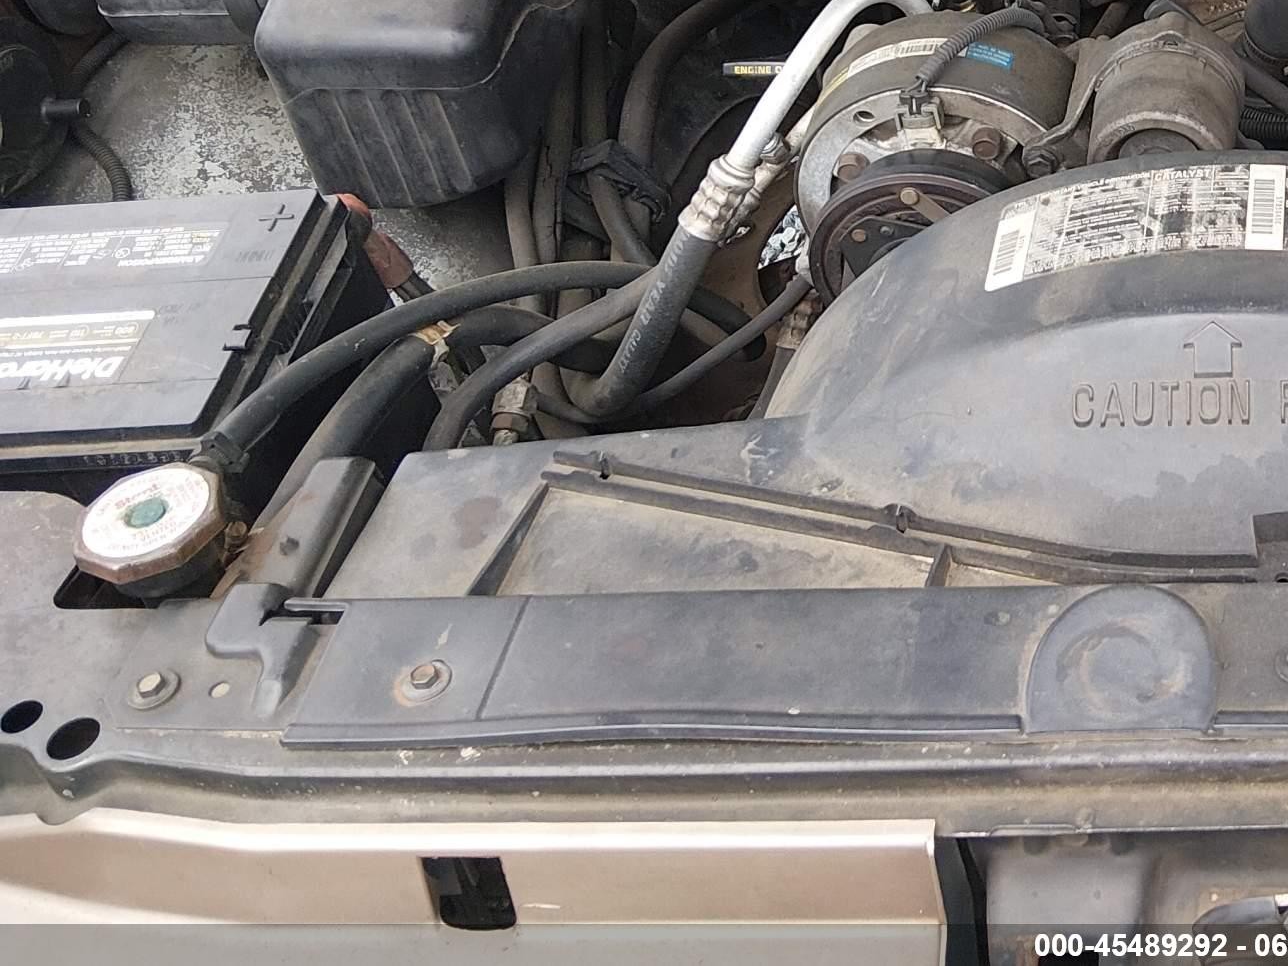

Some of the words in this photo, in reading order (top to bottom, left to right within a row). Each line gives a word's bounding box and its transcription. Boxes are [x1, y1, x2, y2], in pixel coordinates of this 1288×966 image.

[734, 65, 772, 75] ENGINE
[1153, 168, 1213, 182] CATALYST
[1071, 378, 1251, 428] CAUTION
